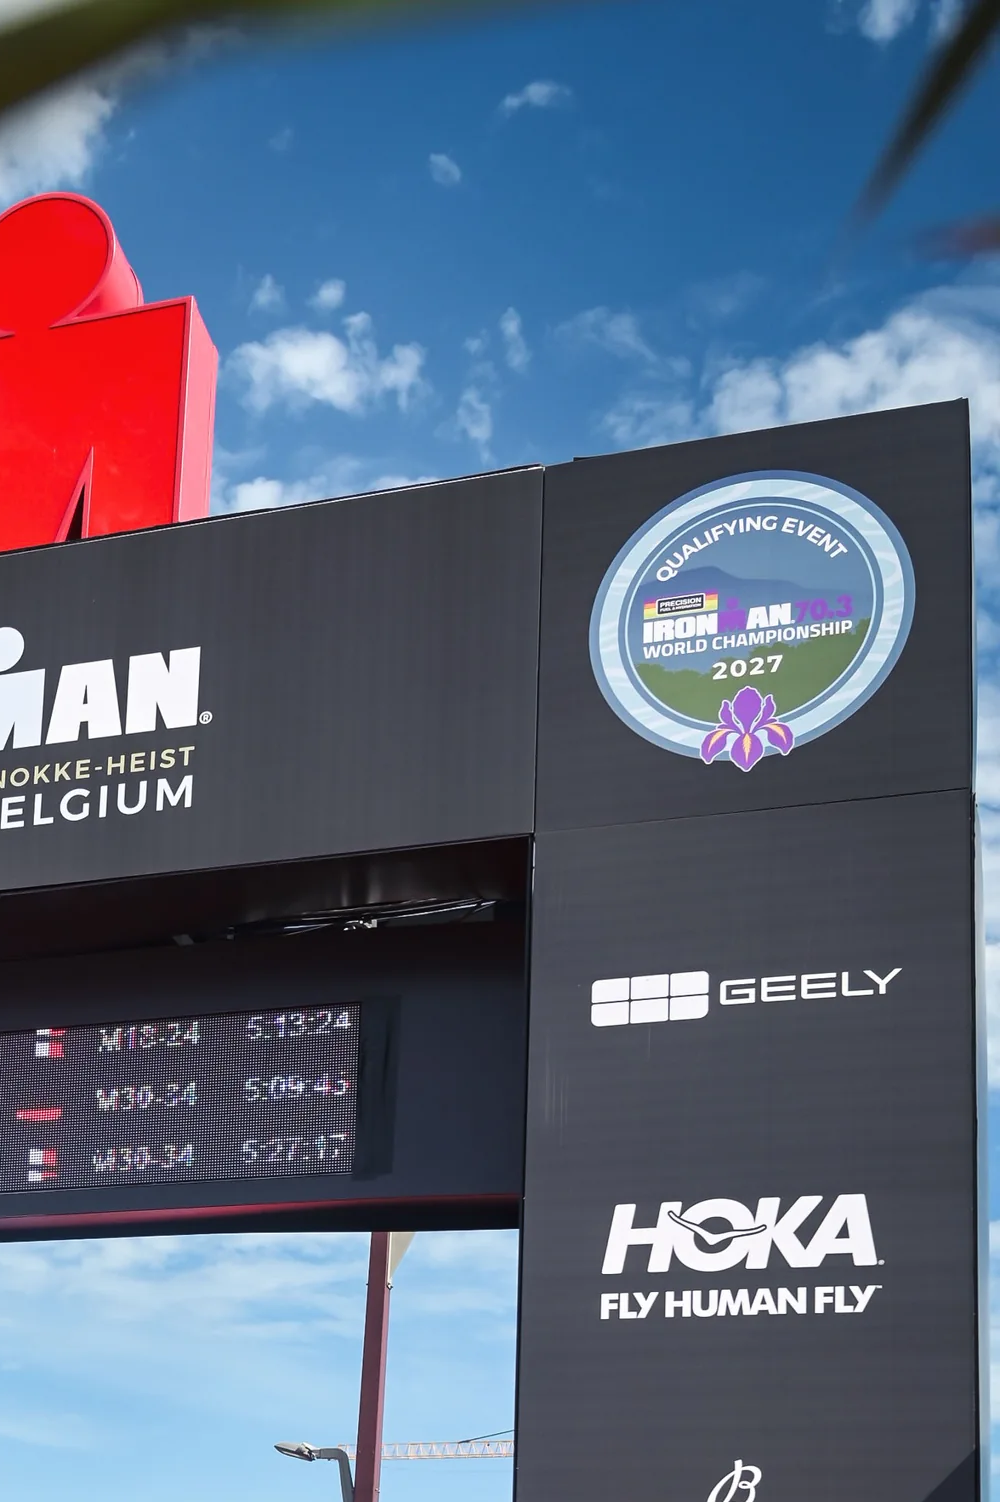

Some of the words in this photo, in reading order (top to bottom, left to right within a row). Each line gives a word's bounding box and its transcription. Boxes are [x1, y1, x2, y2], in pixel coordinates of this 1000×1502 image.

[656, 515, 778, 582] QUALIFYING
[781, 517, 848, 558] EVENT
[643, 598, 792, 643] IRONMAN
[795, 594, 853, 623] 70.3
[660, 597, 702, 608] PRECISION
[643, 639, 707, 659] WORLD
[712, 620, 853, 650] CHAMPIONSHIP
[712, 654, 783, 680] 2027
[719, 968, 903, 1005] GEELY
[97, 1082, 197, 1111] M30-34
[601, 1193, 878, 1275] HOKA
[600, 1291, 659, 1319] FLY
[665, 1286, 807, 1317] HUMAN
[814, 1285, 875, 1314] FLY
